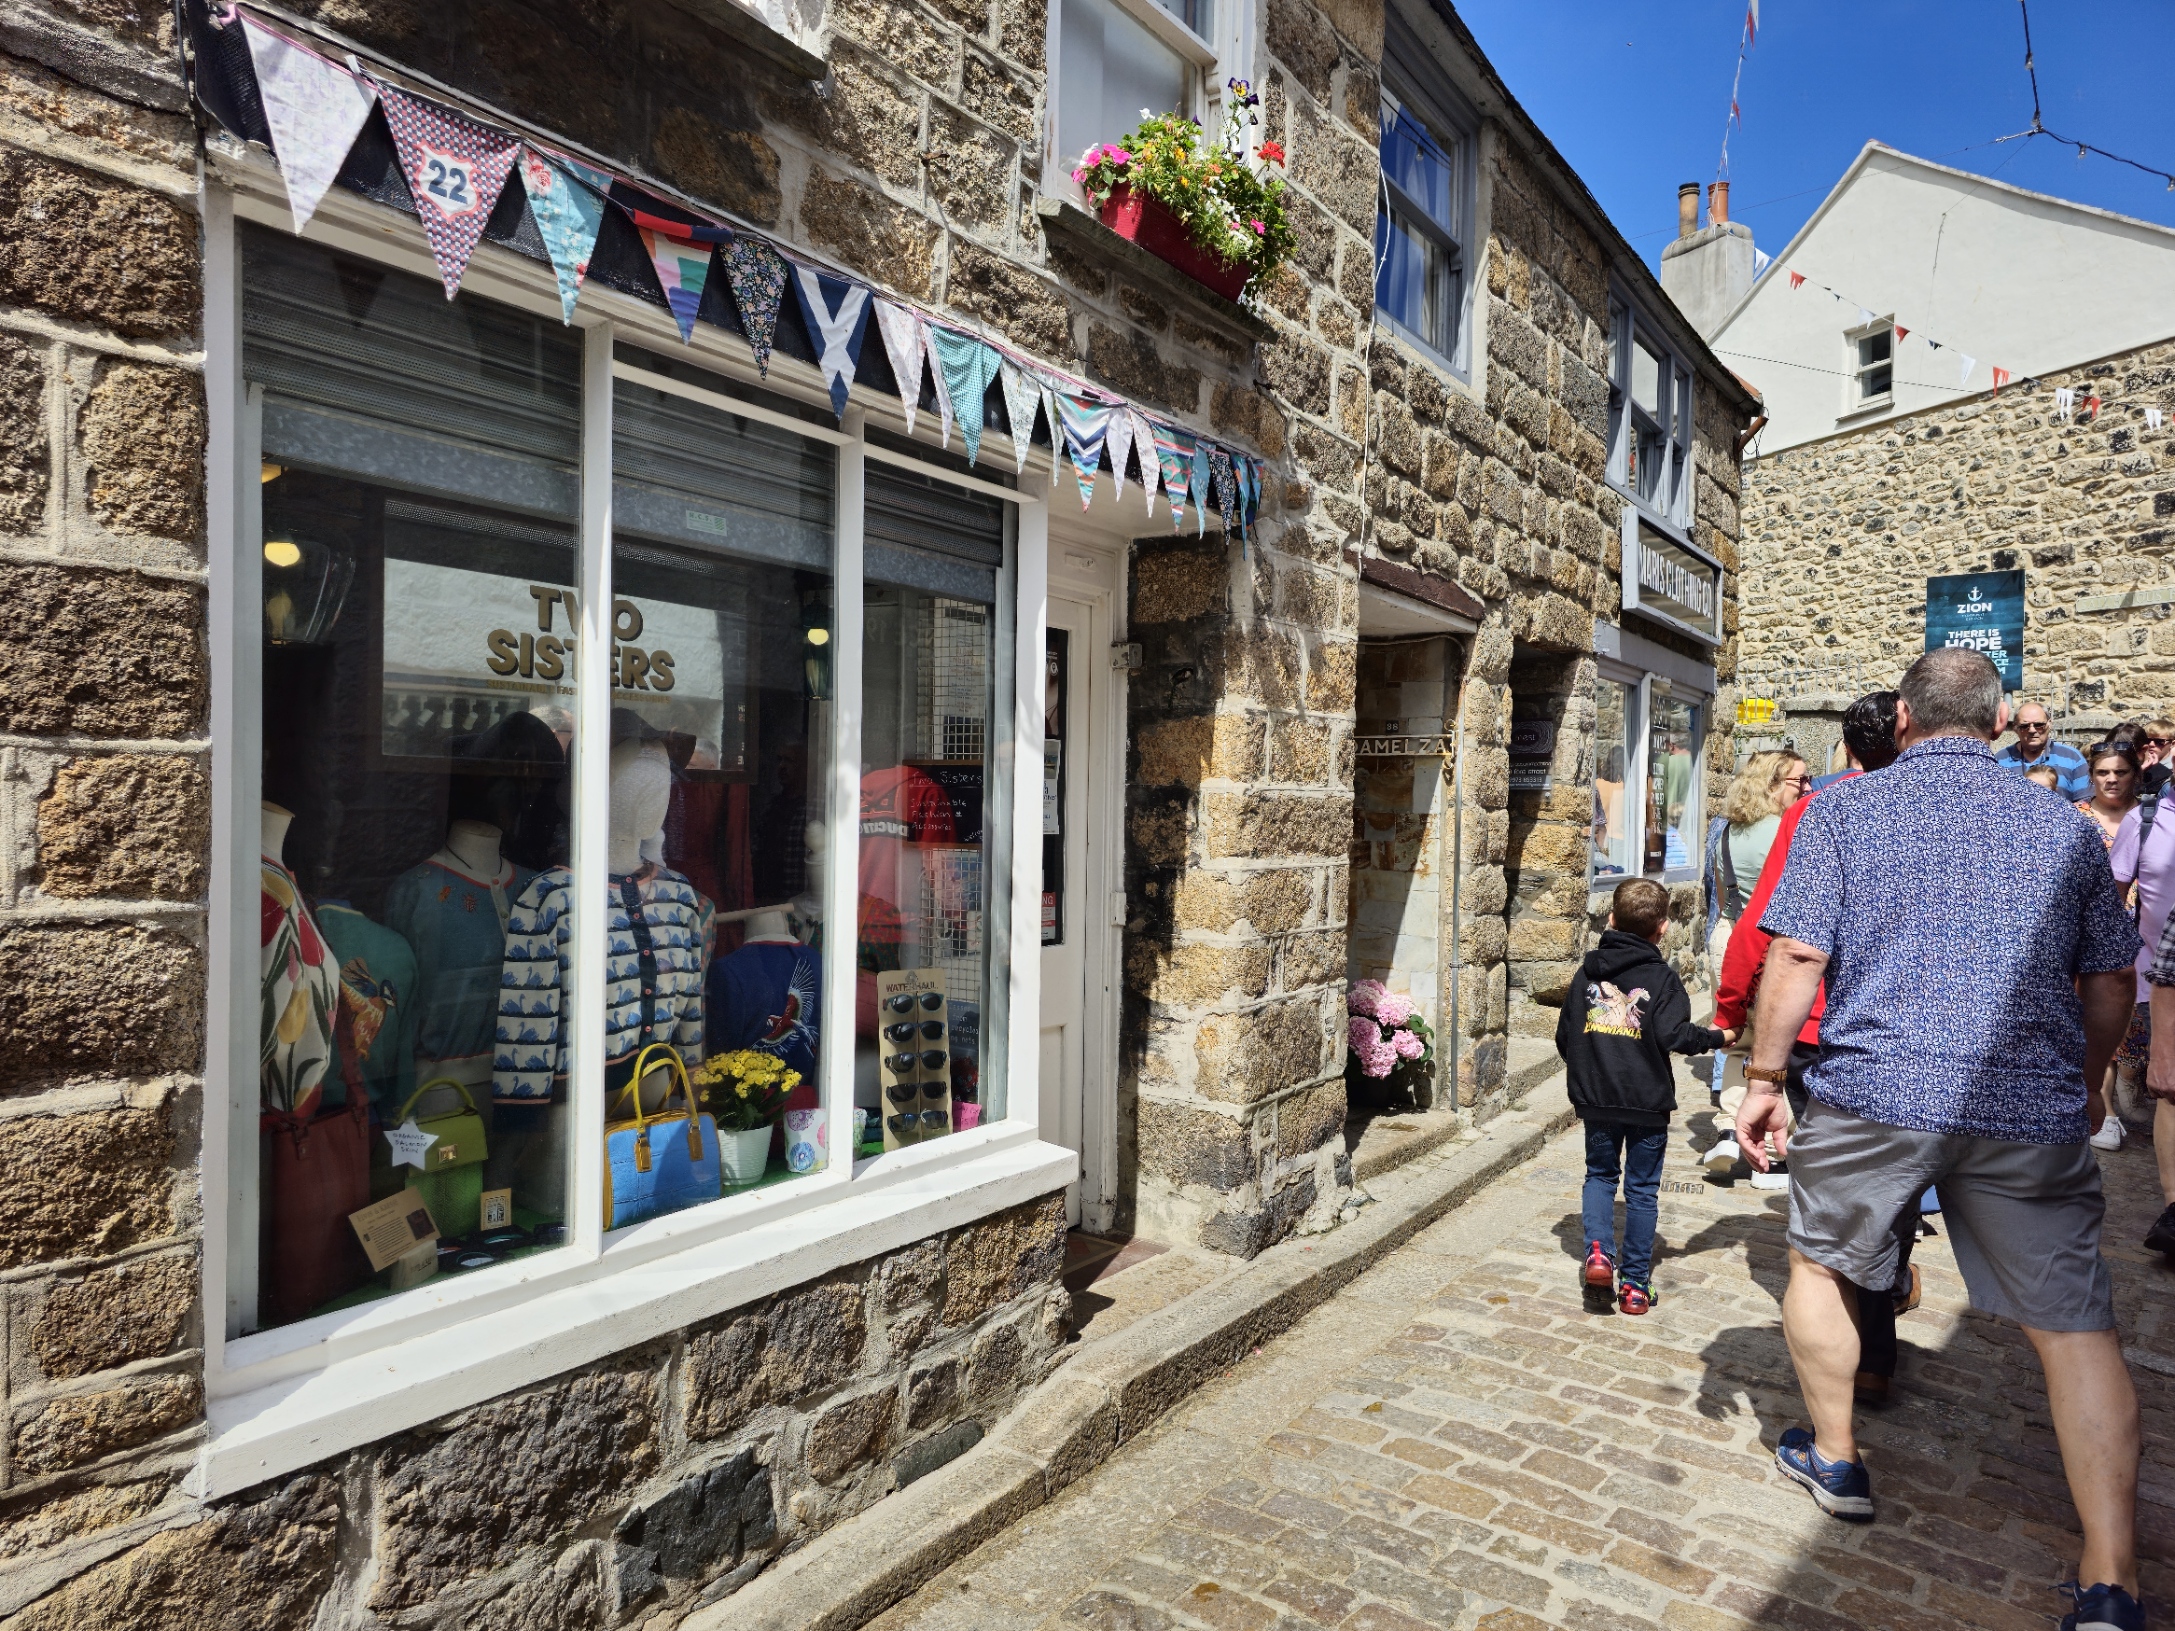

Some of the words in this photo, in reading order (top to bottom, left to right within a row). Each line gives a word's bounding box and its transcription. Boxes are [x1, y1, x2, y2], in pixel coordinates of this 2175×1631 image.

[428, 159, 468, 205] 22
[1666, 559, 1702, 614] CLOTHING
[530, 585, 643, 641] TO
[1957, 602, 1992, 614] ZION
[1945, 636, 2002, 651] HOPE
[1948, 629, 1985, 639] THERE
[1988, 628, 2000, 636] IS
